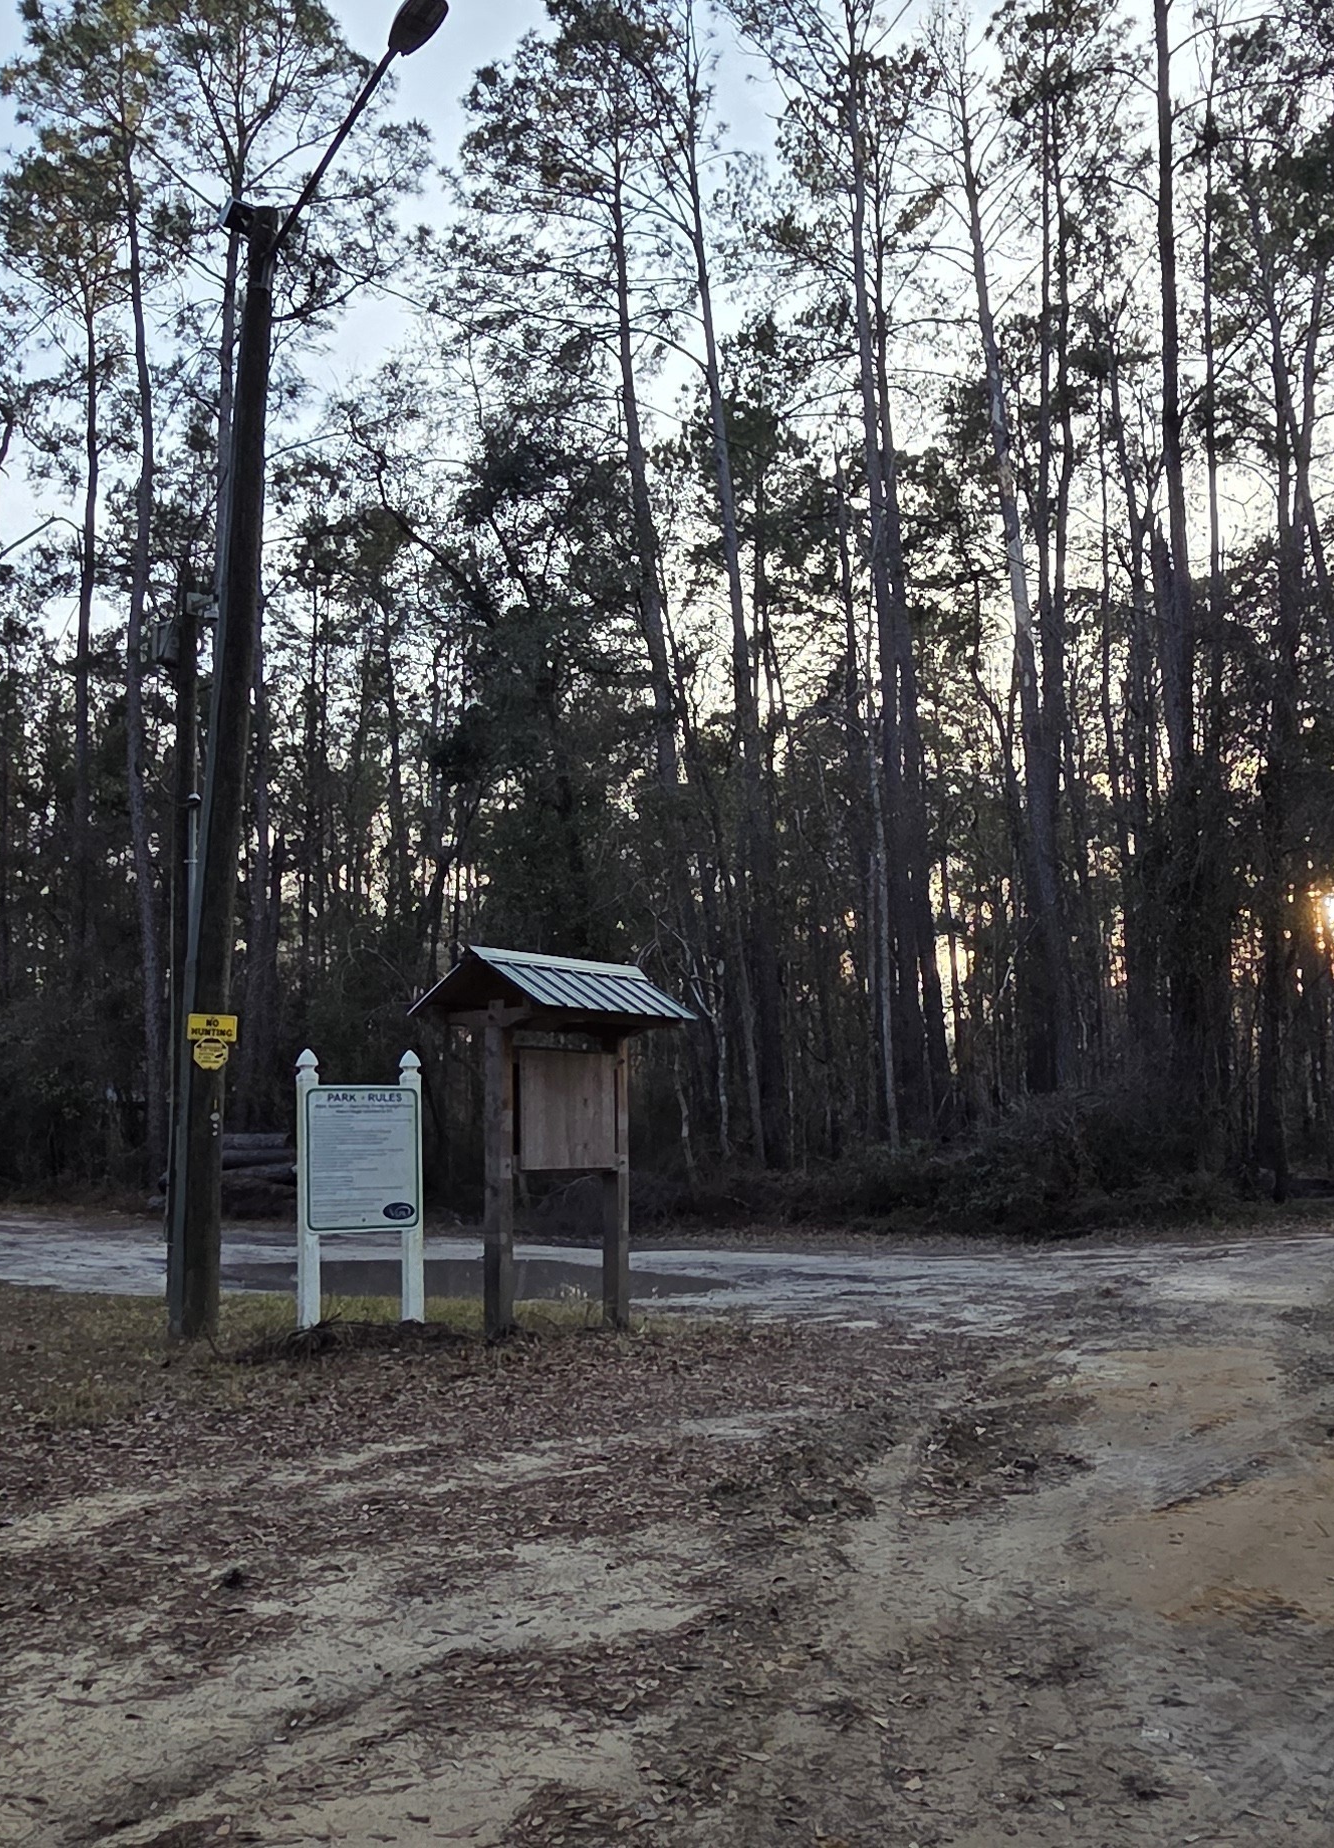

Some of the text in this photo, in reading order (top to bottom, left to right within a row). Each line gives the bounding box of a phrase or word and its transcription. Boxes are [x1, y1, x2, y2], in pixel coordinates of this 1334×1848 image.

[206, 1019, 219, 1027] NO
[191, 1028, 233, 1037] HUNTING
[327, 1093, 402, 1102] PARK RULES
